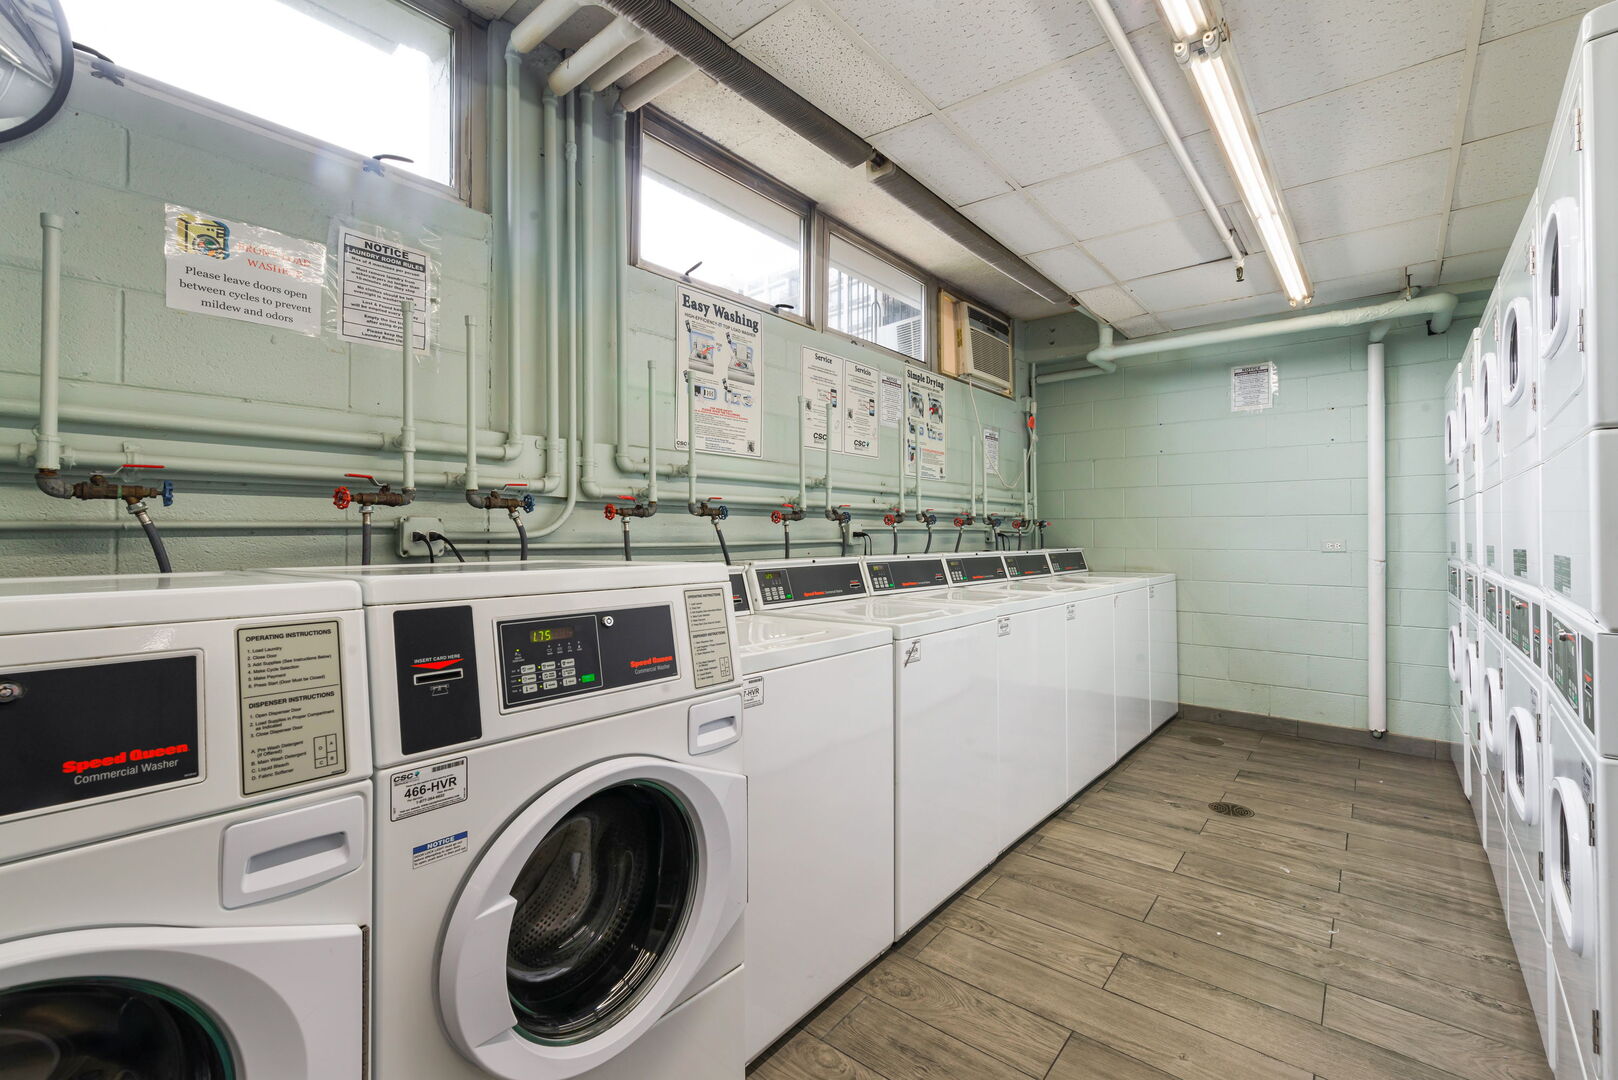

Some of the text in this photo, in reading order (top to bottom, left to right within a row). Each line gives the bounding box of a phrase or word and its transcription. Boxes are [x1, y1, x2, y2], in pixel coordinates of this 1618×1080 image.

[347, 247, 424, 271] LAUNDRY ROOM RULES
[364, 241, 409, 260] NOTICE
[185, 266, 308, 300] Please leave doors open
[179, 279, 312, 314] between cycles to prevent
[201, 298, 294, 324] mildew and odors
[682, 294, 710, 318] Easy
[713, 304, 759, 334] Washing
[814, 353, 833, 365] Service
[854, 365, 871, 376] Servicio
[906, 369, 925, 383] Simple
[926, 376, 945, 391] Drying
[813, 432, 828, 441] CSC
[245, 629, 332, 642] OPERATING INSTRUCTIONS
[630, 657, 652, 668] Speed
[249, 691, 335, 709] DISPENSER INSTRUCTIONS
[61, 743, 189, 774] Speed Queen
[73, 759, 179, 785] Commercial Washer
[393, 773, 414, 783] CSC
[404, 776, 457, 798] 466-HVR
[427, 836, 455, 849] NOTICE
